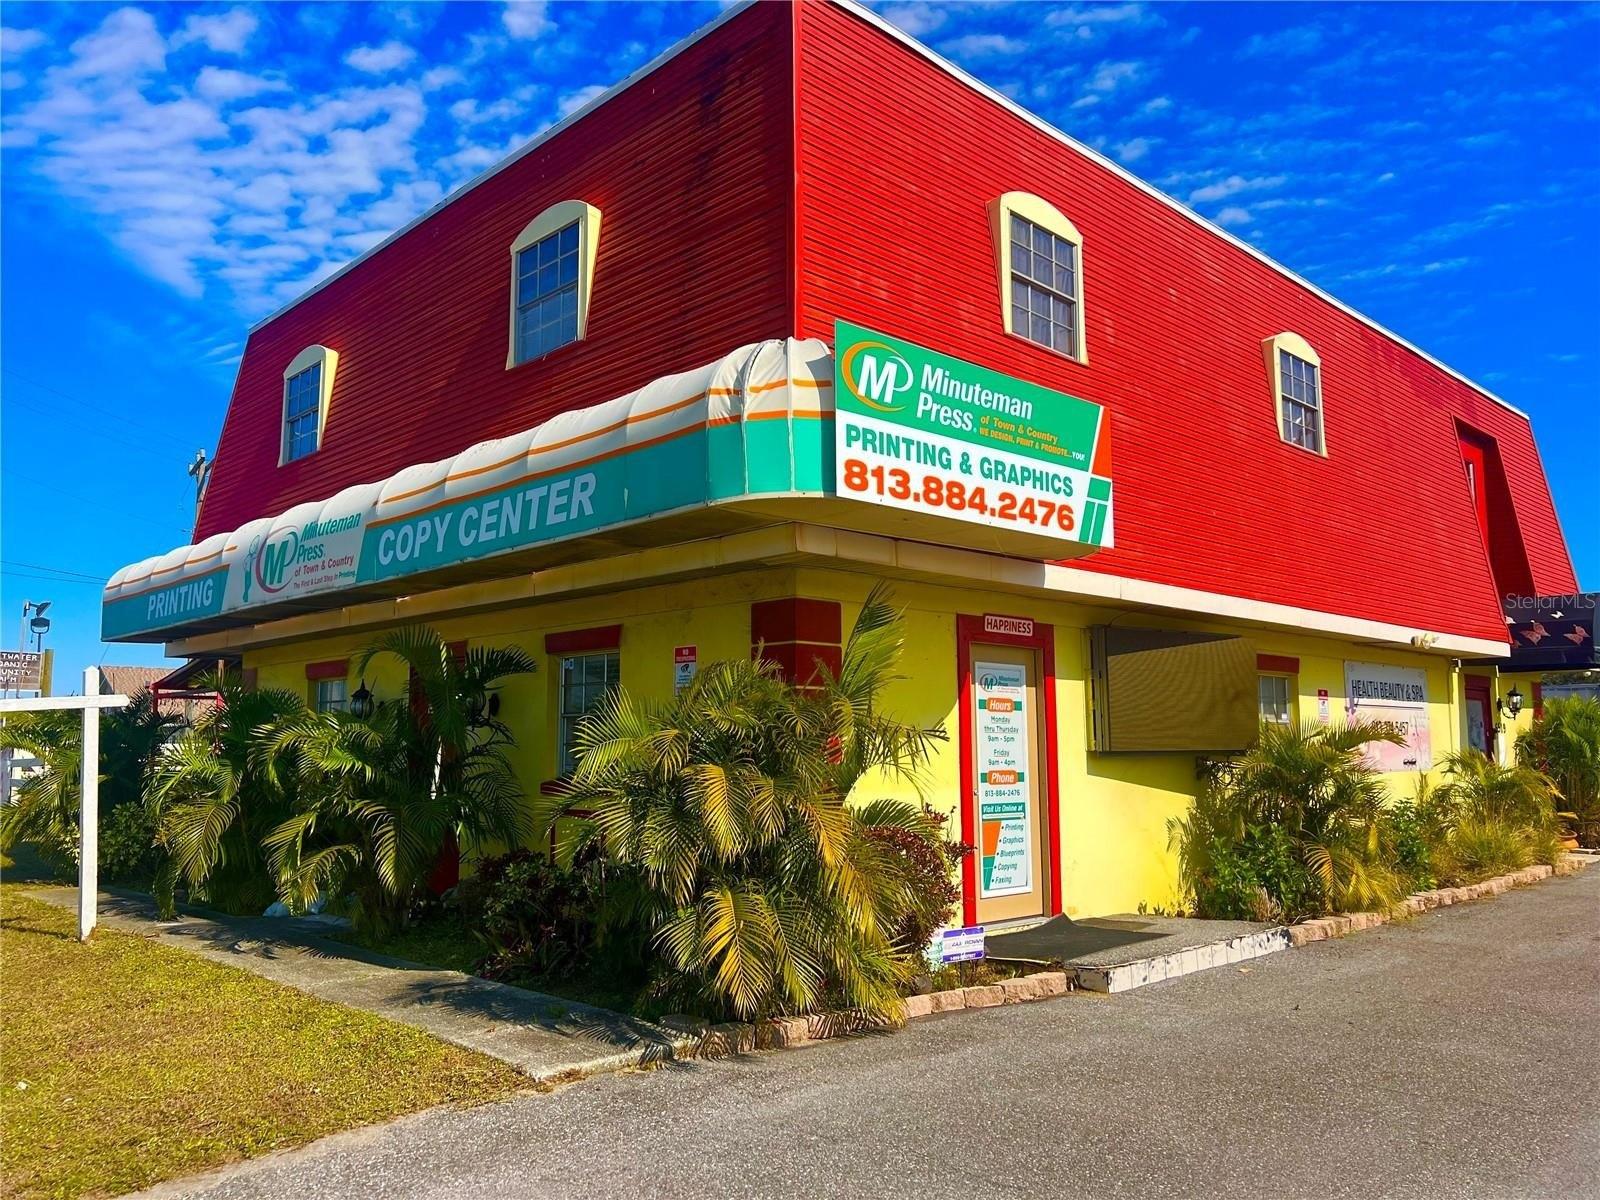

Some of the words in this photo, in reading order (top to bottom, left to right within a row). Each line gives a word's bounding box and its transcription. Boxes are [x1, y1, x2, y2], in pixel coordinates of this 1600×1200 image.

[920, 363, 1033, 420] Minuteman
[980, 415, 990, 425] of
[993, 417, 1015, 432] Town
[1018, 425, 1024, 434] &
[1026, 427, 1058, 445] Country
[845, 423, 952, 471] PRINTING
[959, 451, 973, 476] &
[980, 456, 1074, 497] GRAPHICS
[843, 458, 1075, 532] 813.884.2476
[378, 512, 453, 566] COPY
[458, 472, 597, 547] CENTER
[300, 512, 362, 542] Minuteman
[294, 566, 301, 577] of
[303, 564, 319, 575] Town
[321, 562, 326, 571] &
[327, 554, 354, 569] Country
[147, 577, 214, 621] PRINTING
[1351, 679, 1379, 698] HEALTH
[1380, 681, 1405, 700] BEAUTY
[1405, 684, 1411, 699] &
[1411, 684, 1424, 700] SPA
[989, 700, 1012, 711] Hours
[990, 715, 1011, 723] Monday
[996, 726, 1019, 734] Thursday
[1003, 735, 1015, 743] 5pm
[993, 748, 1010, 757] Friday
[991, 773, 1015, 784] Phone
[984, 789, 1020, 798] 813-884-2476
[983, 805, 994, 813] Visit
[1001, 804, 1017, 812] Online
[1017, 804, 1023, 812] at
[1004, 823, 1024, 831] Printing
[1002, 837, 1024, 845] Graphics
[1000, 849, 1025, 858] Blueprints
[997, 863, 1017, 871] Copying
[995, 876, 1012, 884] Faxing
